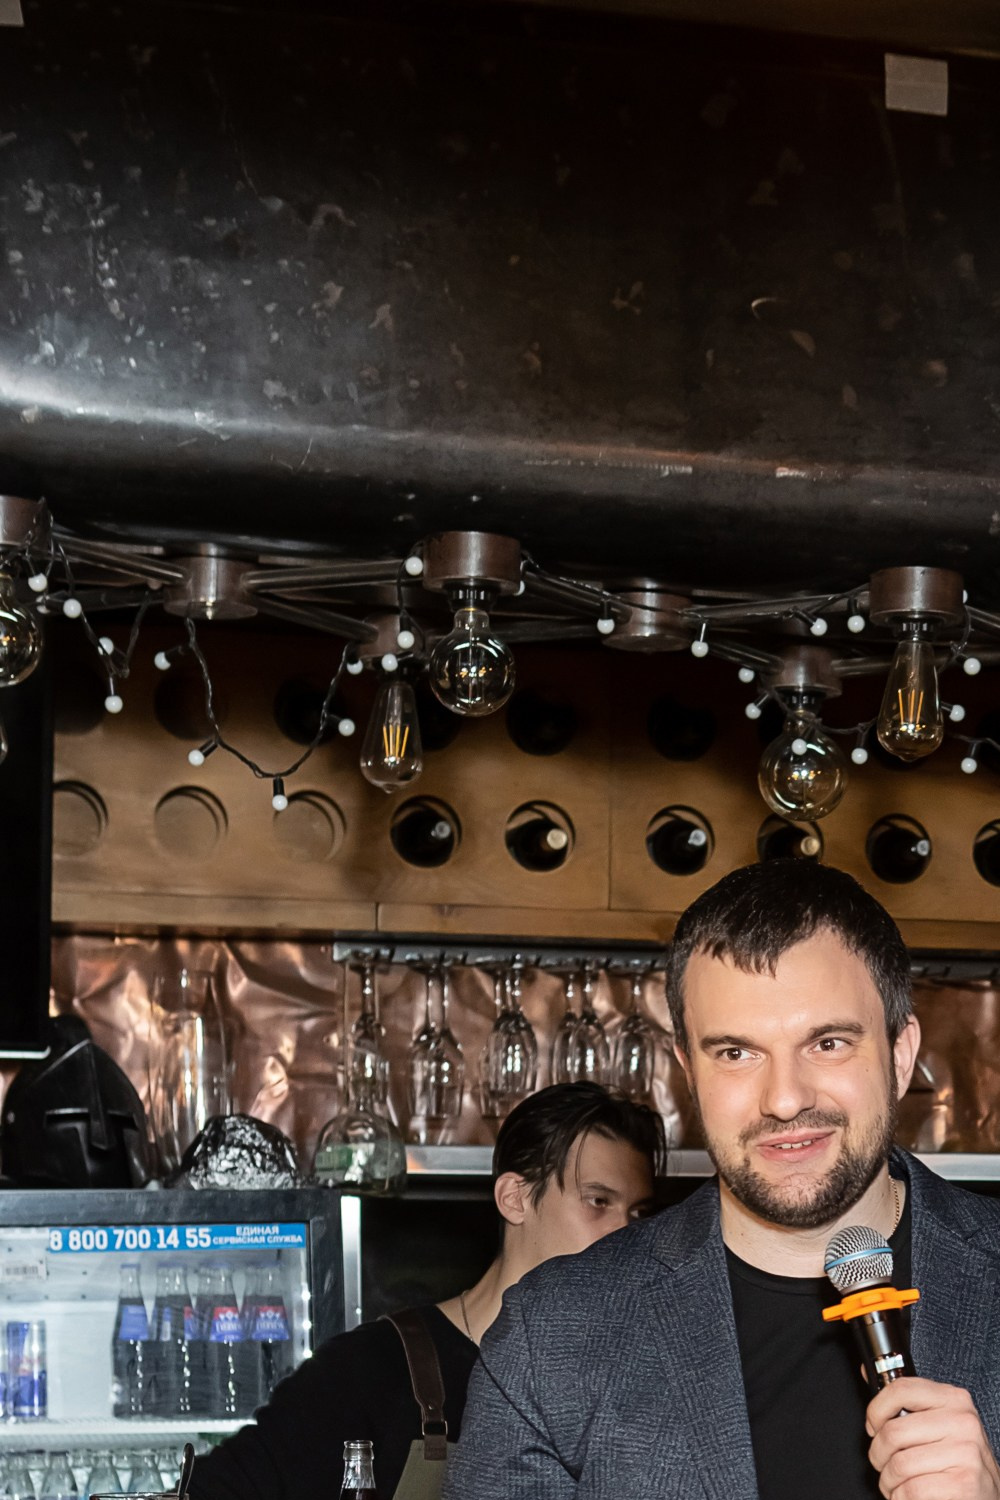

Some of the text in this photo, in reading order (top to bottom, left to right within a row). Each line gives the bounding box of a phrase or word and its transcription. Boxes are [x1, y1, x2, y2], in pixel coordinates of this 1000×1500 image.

[236, 1226, 279, 1236] ЕДИНАЯ
[50, 1227, 212, 1250] 8 800 700 14 55
[212, 1234, 303, 1245] СЕРВИСНАЯ СЛУЖБА
